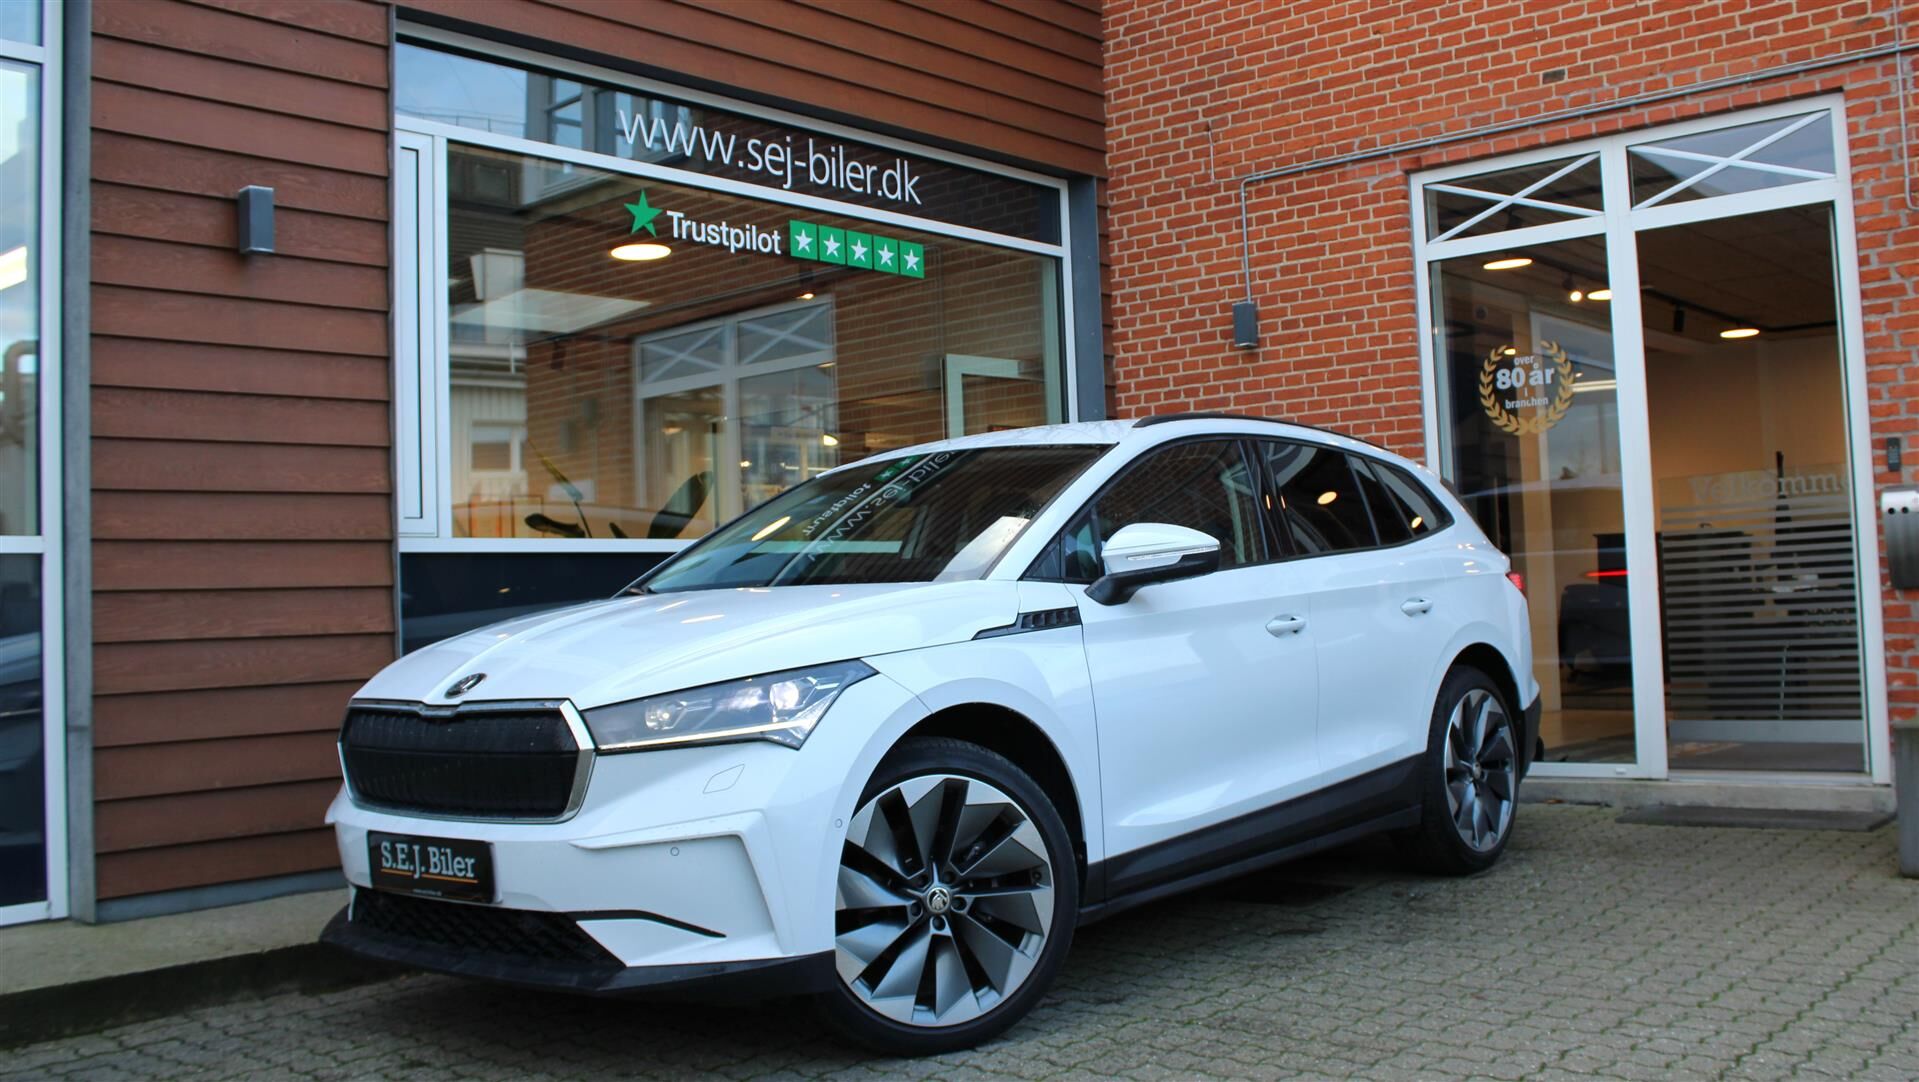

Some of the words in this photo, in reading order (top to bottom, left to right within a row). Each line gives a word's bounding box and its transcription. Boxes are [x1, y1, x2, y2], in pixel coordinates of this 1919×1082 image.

[618, 109, 922, 205] www.sej-biler.dk
[666, 210, 781, 255] Trustpilot
[1496, 367, 1526, 390] 80
[1529, 362, 1555, 386] år
[1514, 355, 1534, 366] over
[1505, 397, 1549, 409] branchen
[380, 840, 426, 879] S.E.J.
[427, 846, 476, 878] Biler
